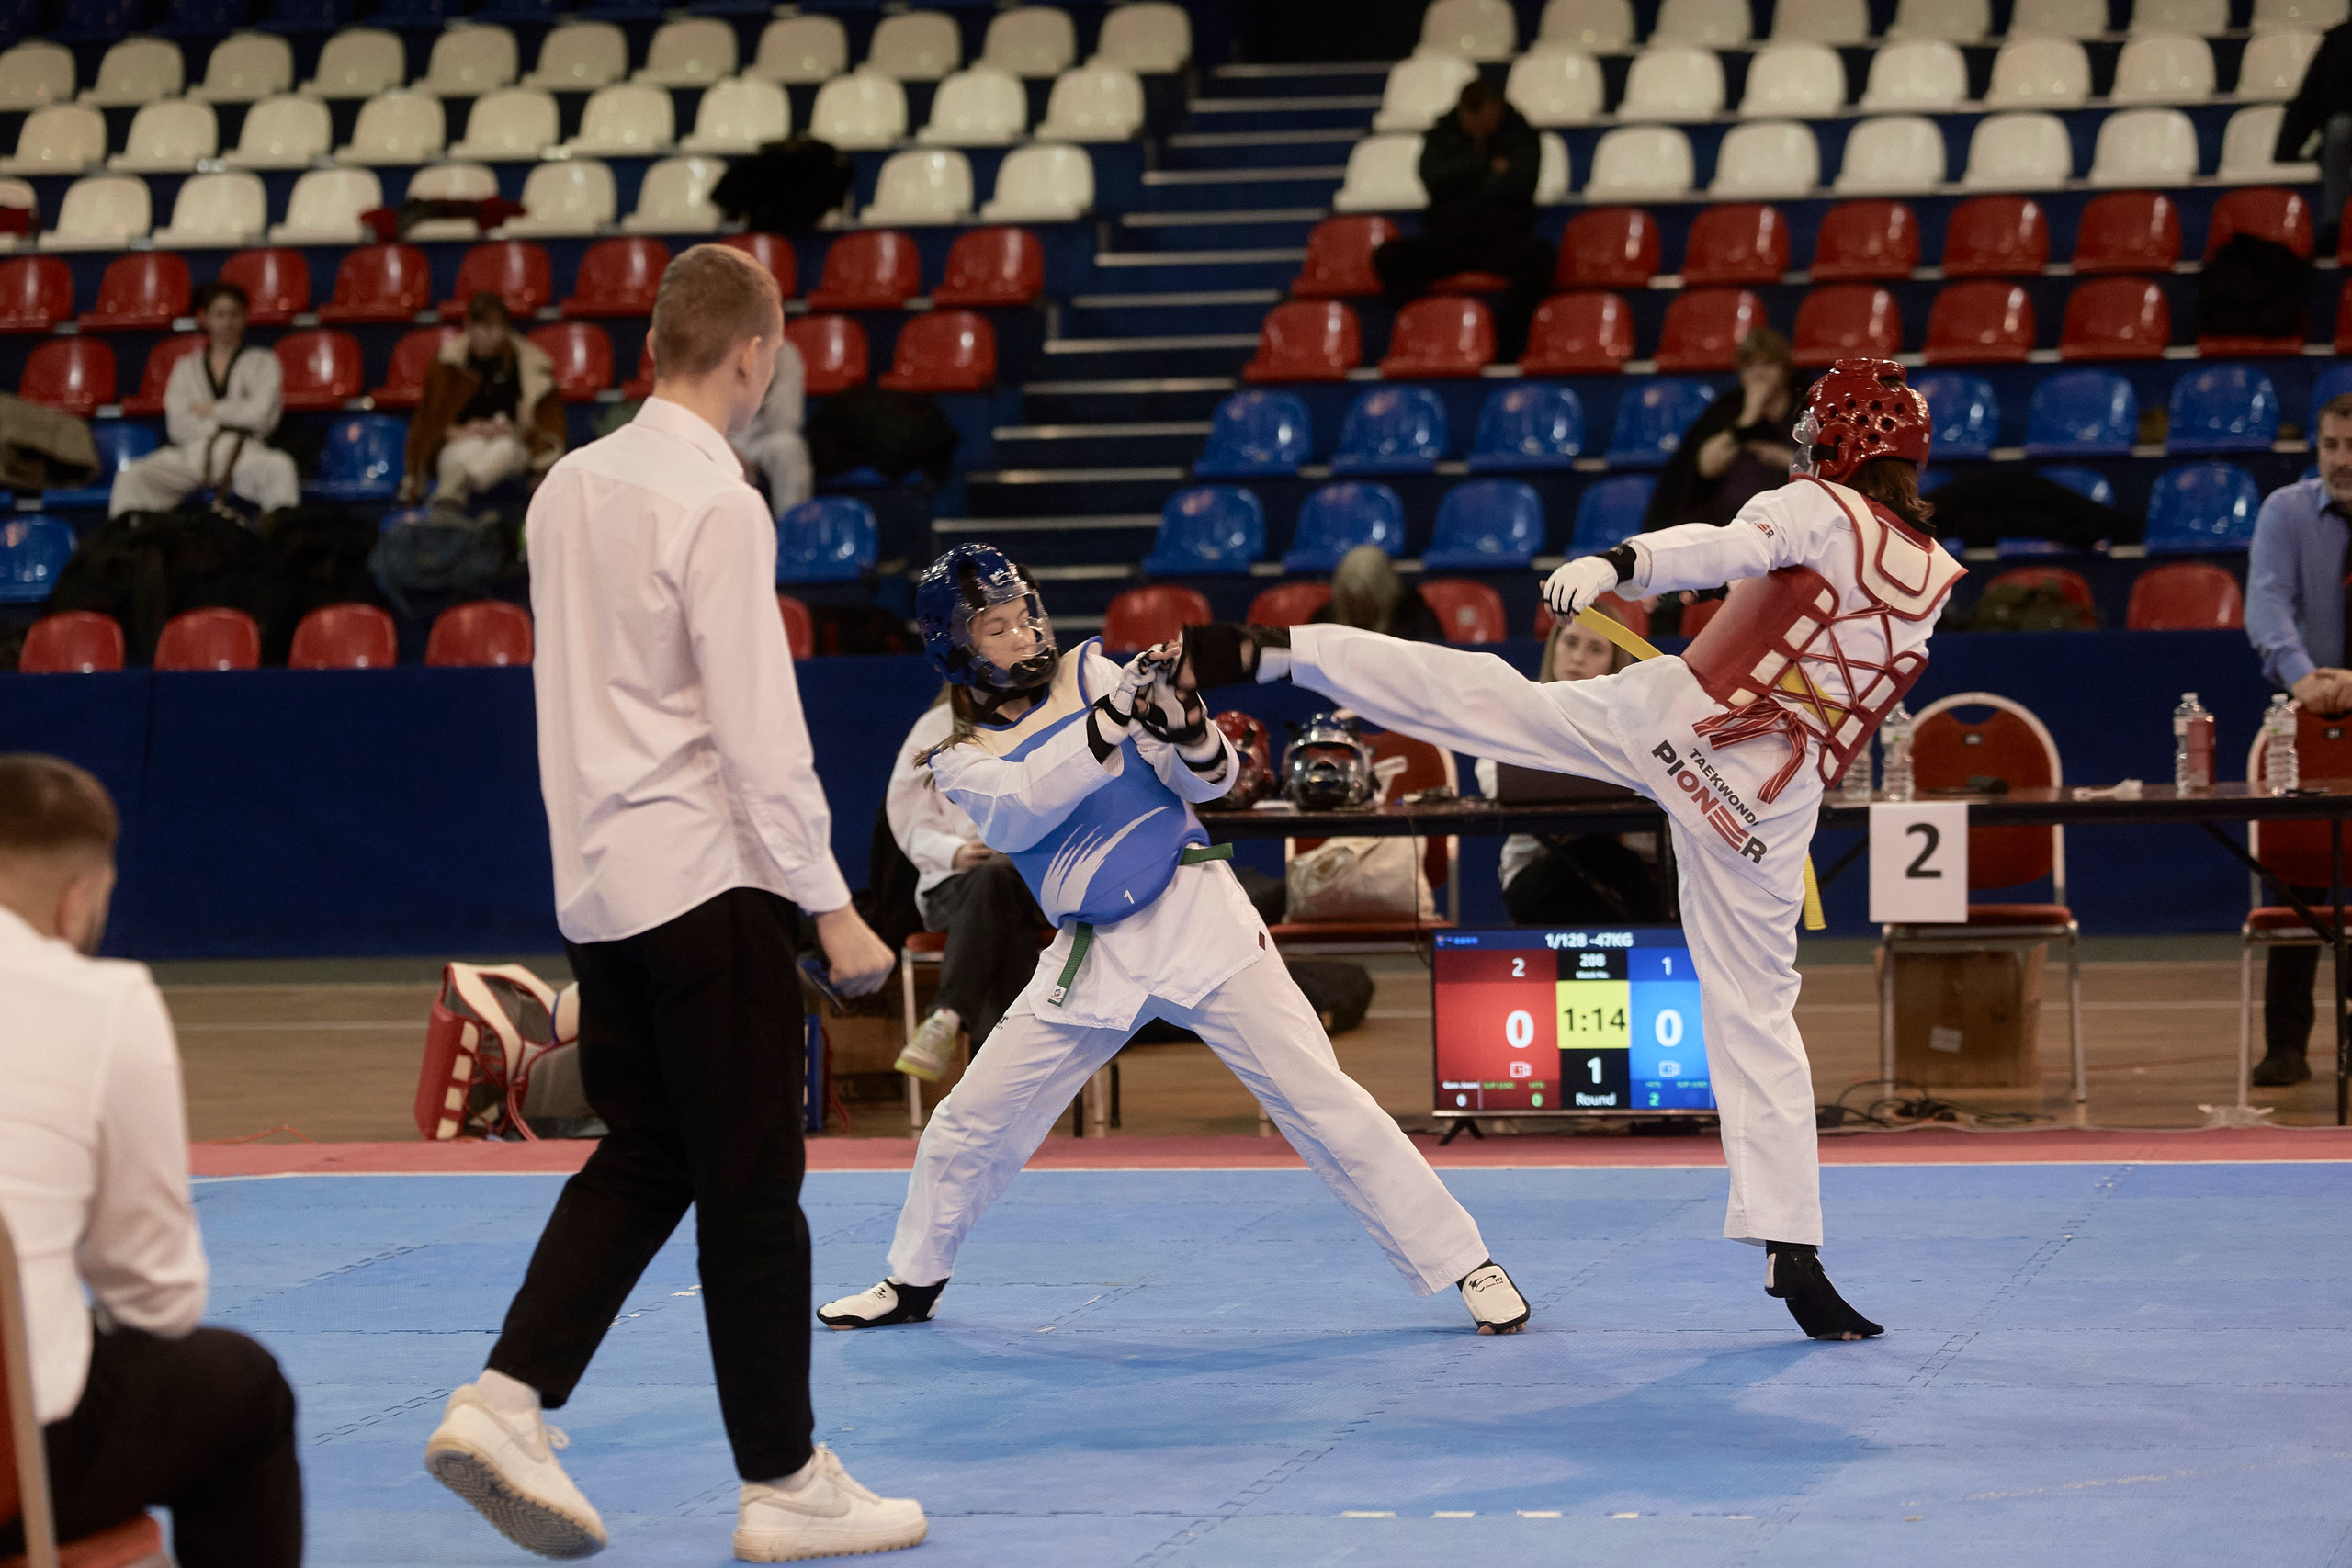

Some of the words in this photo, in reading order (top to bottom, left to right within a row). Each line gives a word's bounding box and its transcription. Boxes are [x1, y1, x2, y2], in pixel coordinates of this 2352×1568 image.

[1905, 822, 1942, 878] 2
[1123, 889, 1136, 905] 1
[1544, 932, 1588, 950] 1/128
[1589, 931, 1634, 948] -47KG
[1511, 957, 1526, 977] 2
[1661, 956, 1672, 976] 1
[1505, 1010, 1534, 1049] 0
[1563, 1008, 1626, 1032] 1:14
[1655, 1009, 1683, 1047] 0
[1587, 1057, 1602, 1084] 1
[1575, 1091, 1618, 1106] Round
[1648, 1092, 1661, 1107] 2
